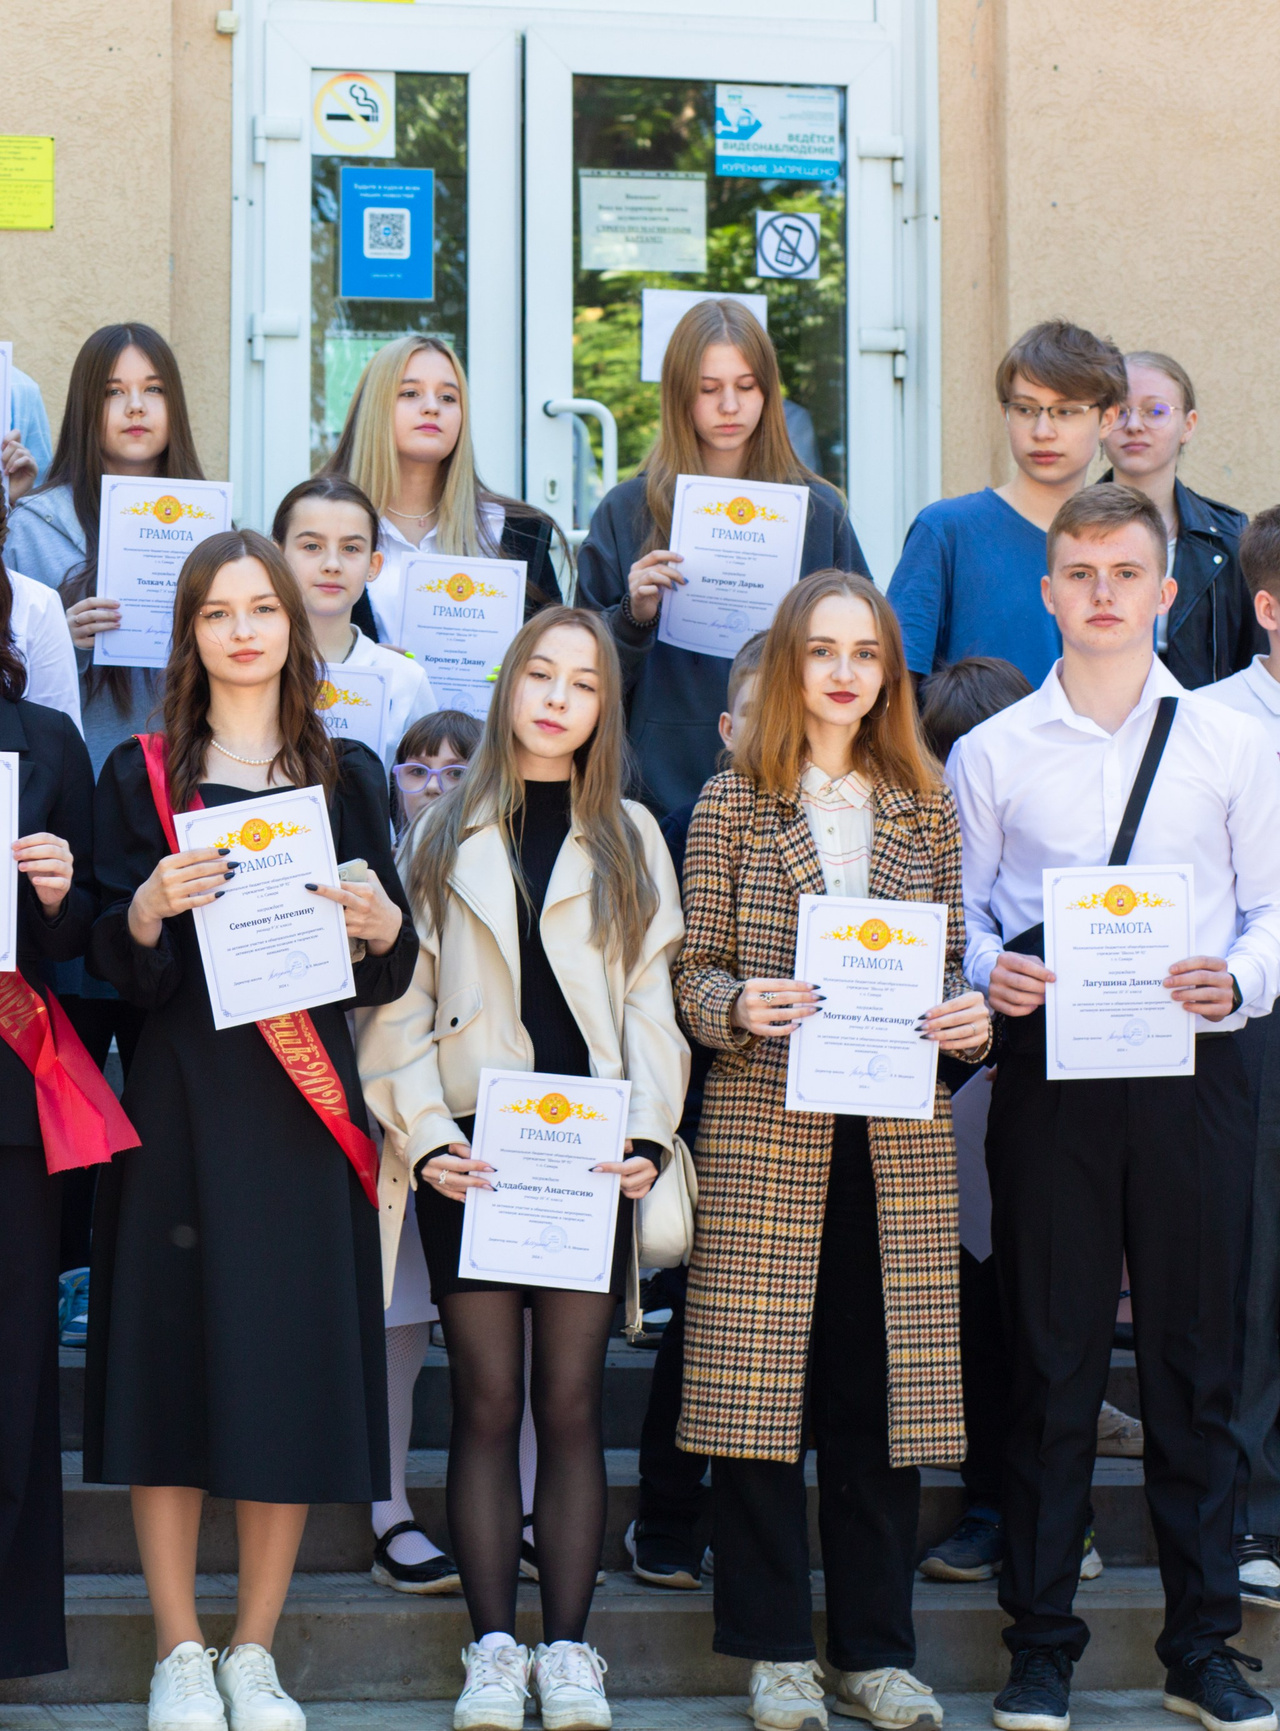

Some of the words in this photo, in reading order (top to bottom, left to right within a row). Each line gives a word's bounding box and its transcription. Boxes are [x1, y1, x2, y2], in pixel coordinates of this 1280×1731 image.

[788, 133, 835, 144] ВЕДЁТСЯ
[723, 142, 835, 155] ВИДЕОНАБЛЮДЕНИЕ
[722, 163, 767, 173] КУРЕНИЕ
[772, 164, 835, 176] ЗАПРЕЩЕНО
[139, 528, 194, 542] ГРАМОТА
[712, 528, 766, 543] ГРАМОТА
[137, 578, 164, 587] Толкач
[702, 576, 737, 588] Батурову
[738, 580, 764, 589] Дарью
[433, 606, 485, 620] ГРАМОТА
[425, 655, 460, 665] Королеву
[461, 657, 486, 667] Диану
[229, 916, 271, 930] Семенову
[274, 907, 314, 921] Ангелину
[1090, 922, 1152, 935] ГРАМОТА
[842, 955, 903, 971] ГРАМОТА
[1082, 979, 1127, 988] Лагушина
[1128, 978, 1163, 987] Данилу
[823, 1011, 861, 1022] Моткову
[863, 1014, 915, 1026] Александру
[519, 1127, 582, 1144] ГРАМОТА
[495, 1180, 542, 1193] Алдабаеву
[544, 1186, 594, 1197] Анастасию
